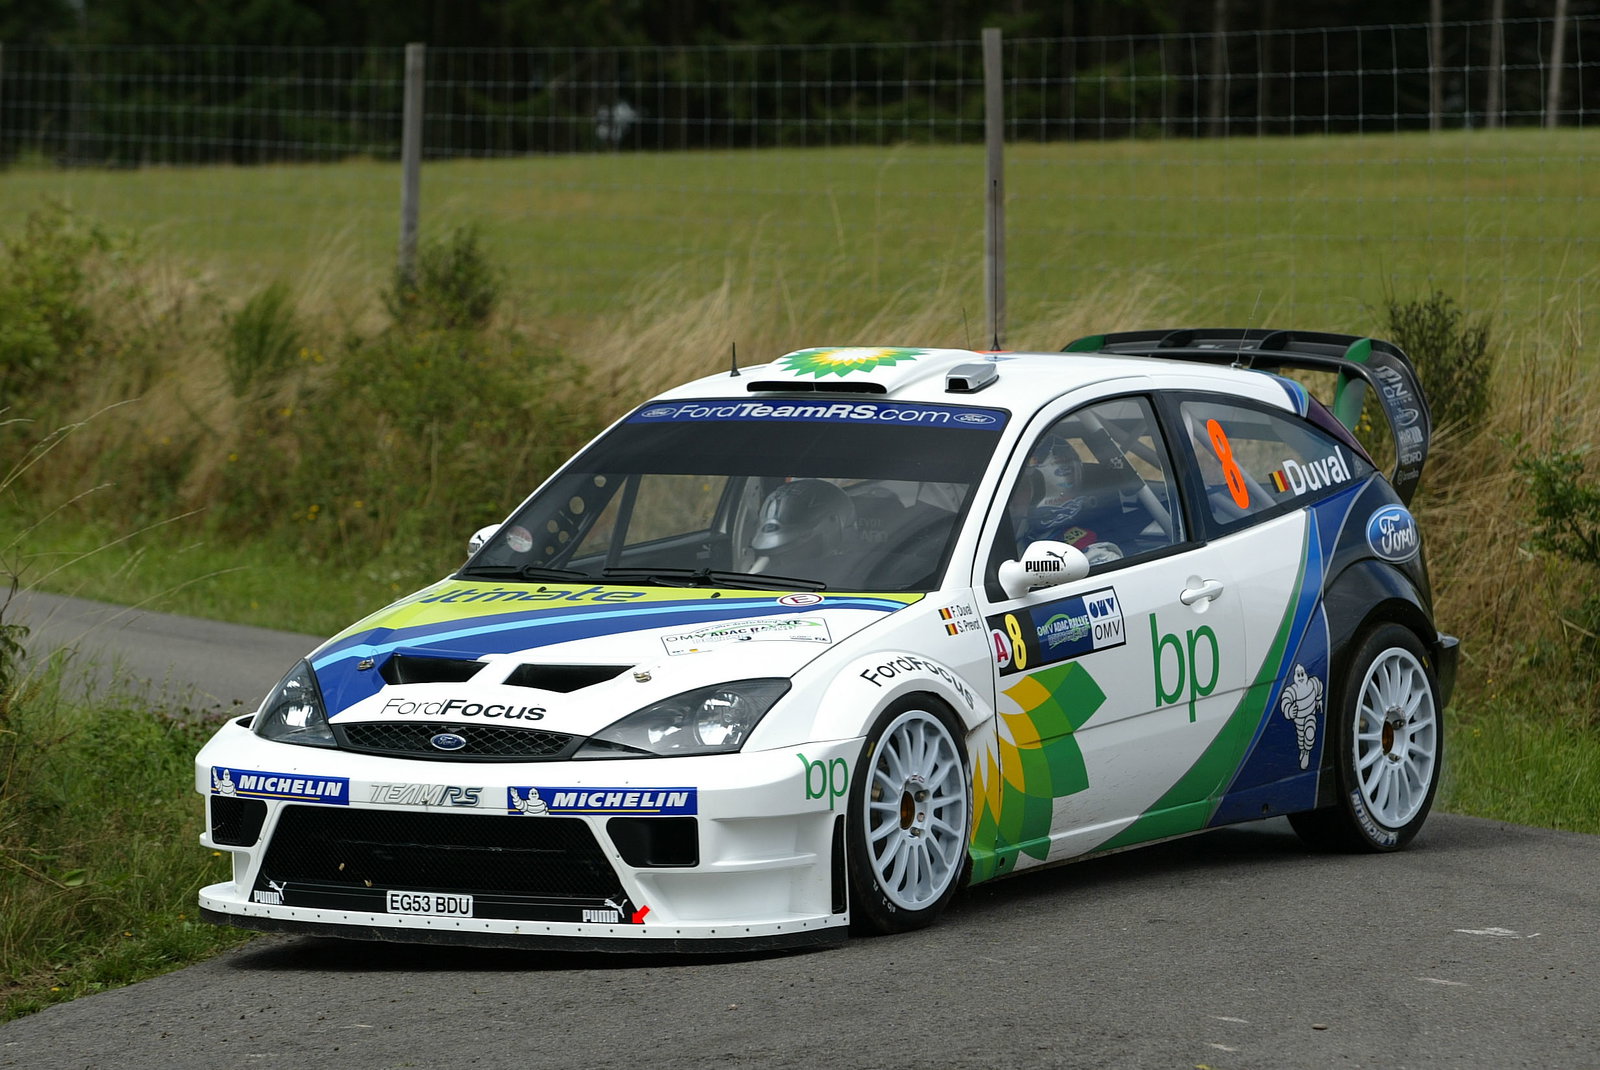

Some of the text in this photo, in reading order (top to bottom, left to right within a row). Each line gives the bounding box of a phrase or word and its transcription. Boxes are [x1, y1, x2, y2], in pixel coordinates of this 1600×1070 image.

[673, 403, 950, 423] FordTeamRS.com
[1206, 418, 1250, 509] 8
[1282, 445, 1351, 496] Duval
[1379, 513, 1416, 555] Ford
[1025, 560, 1060, 572] PUMA
[417, 586, 648, 604] ltimate
[790, 595, 814, 604] E
[709, 627, 748, 638] ADAC
[1036, 624, 1055, 637] OMV
[1054, 618, 1070, 633] ADAC
[1068, 614, 1090, 630] RALLYE
[1094, 619, 1120, 640] OMV
[993, 632, 1009, 663] A
[1004, 613, 1027, 670] 8
[1149, 612, 1220, 723] bp
[380, 698, 547, 721] FordFocus
[238, 774, 343, 797] MICHELIN
[796, 752, 849, 811] bp
[552, 791, 689, 808] MICHELIN
[1351, 792, 1388, 844] MICHELIN
[254, 890, 281, 905] PUMA
[390, 893, 470, 915] EG53 BDU
[582, 909, 619, 923] PUMA
